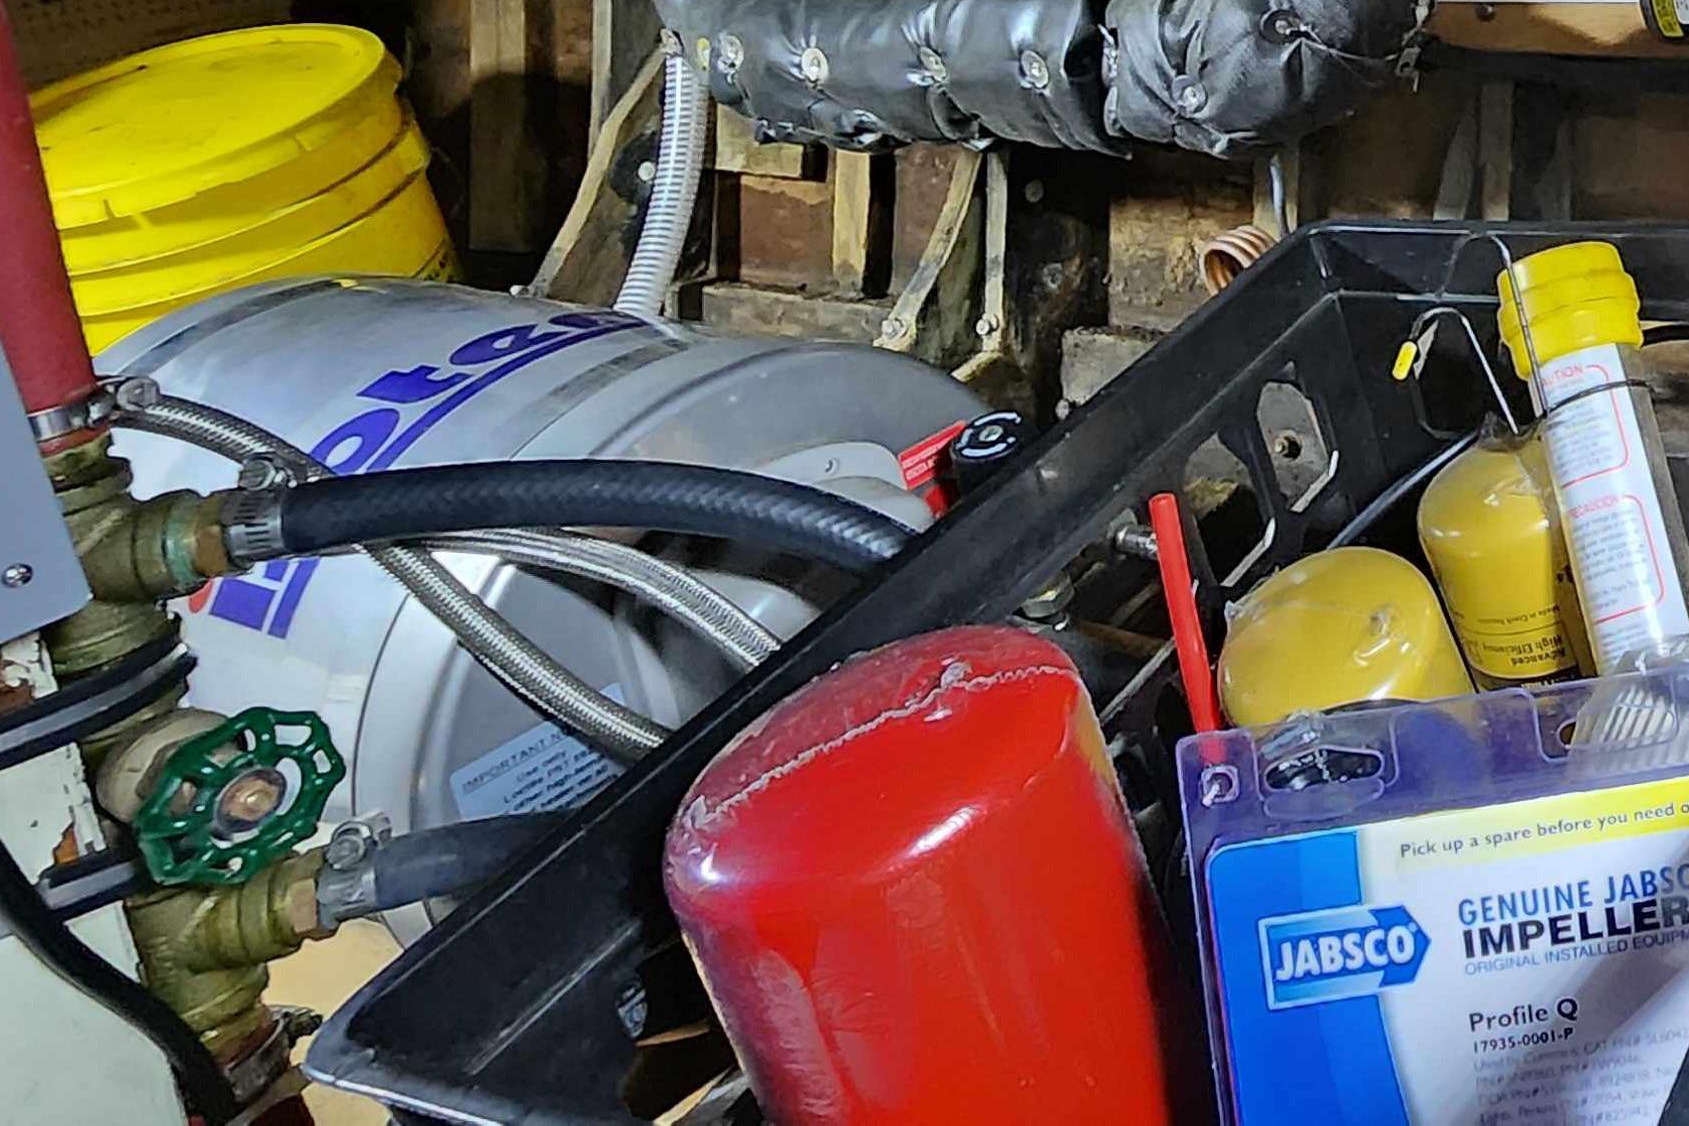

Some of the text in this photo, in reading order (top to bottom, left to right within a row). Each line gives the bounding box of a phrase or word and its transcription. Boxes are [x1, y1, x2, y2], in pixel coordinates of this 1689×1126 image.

[1509, 647, 1566, 667] Advanced
[1535, 634, 1564, 649] High
[461, 738, 547, 794] IMPORTANT
[1399, 839, 1438, 859] Pick
[1441, 837, 1465, 855] up
[1468, 836, 1480, 849] a
[1484, 828, 1533, 849] spare
[1536, 816, 1594, 837] before
[1596, 811, 1628, 832] you
[1634, 803, 1676, 822] need
[1458, 879, 1594, 926] GENUINE
[1276, 924, 1416, 982] JABSCO
[1464, 952, 1542, 976] ORIGINAL
[1545, 938, 1629, 964] INSTALLED
[1468, 997, 1579, 1033] Profile Q
[1472, 1026, 1575, 1055] 17935-0001-P
